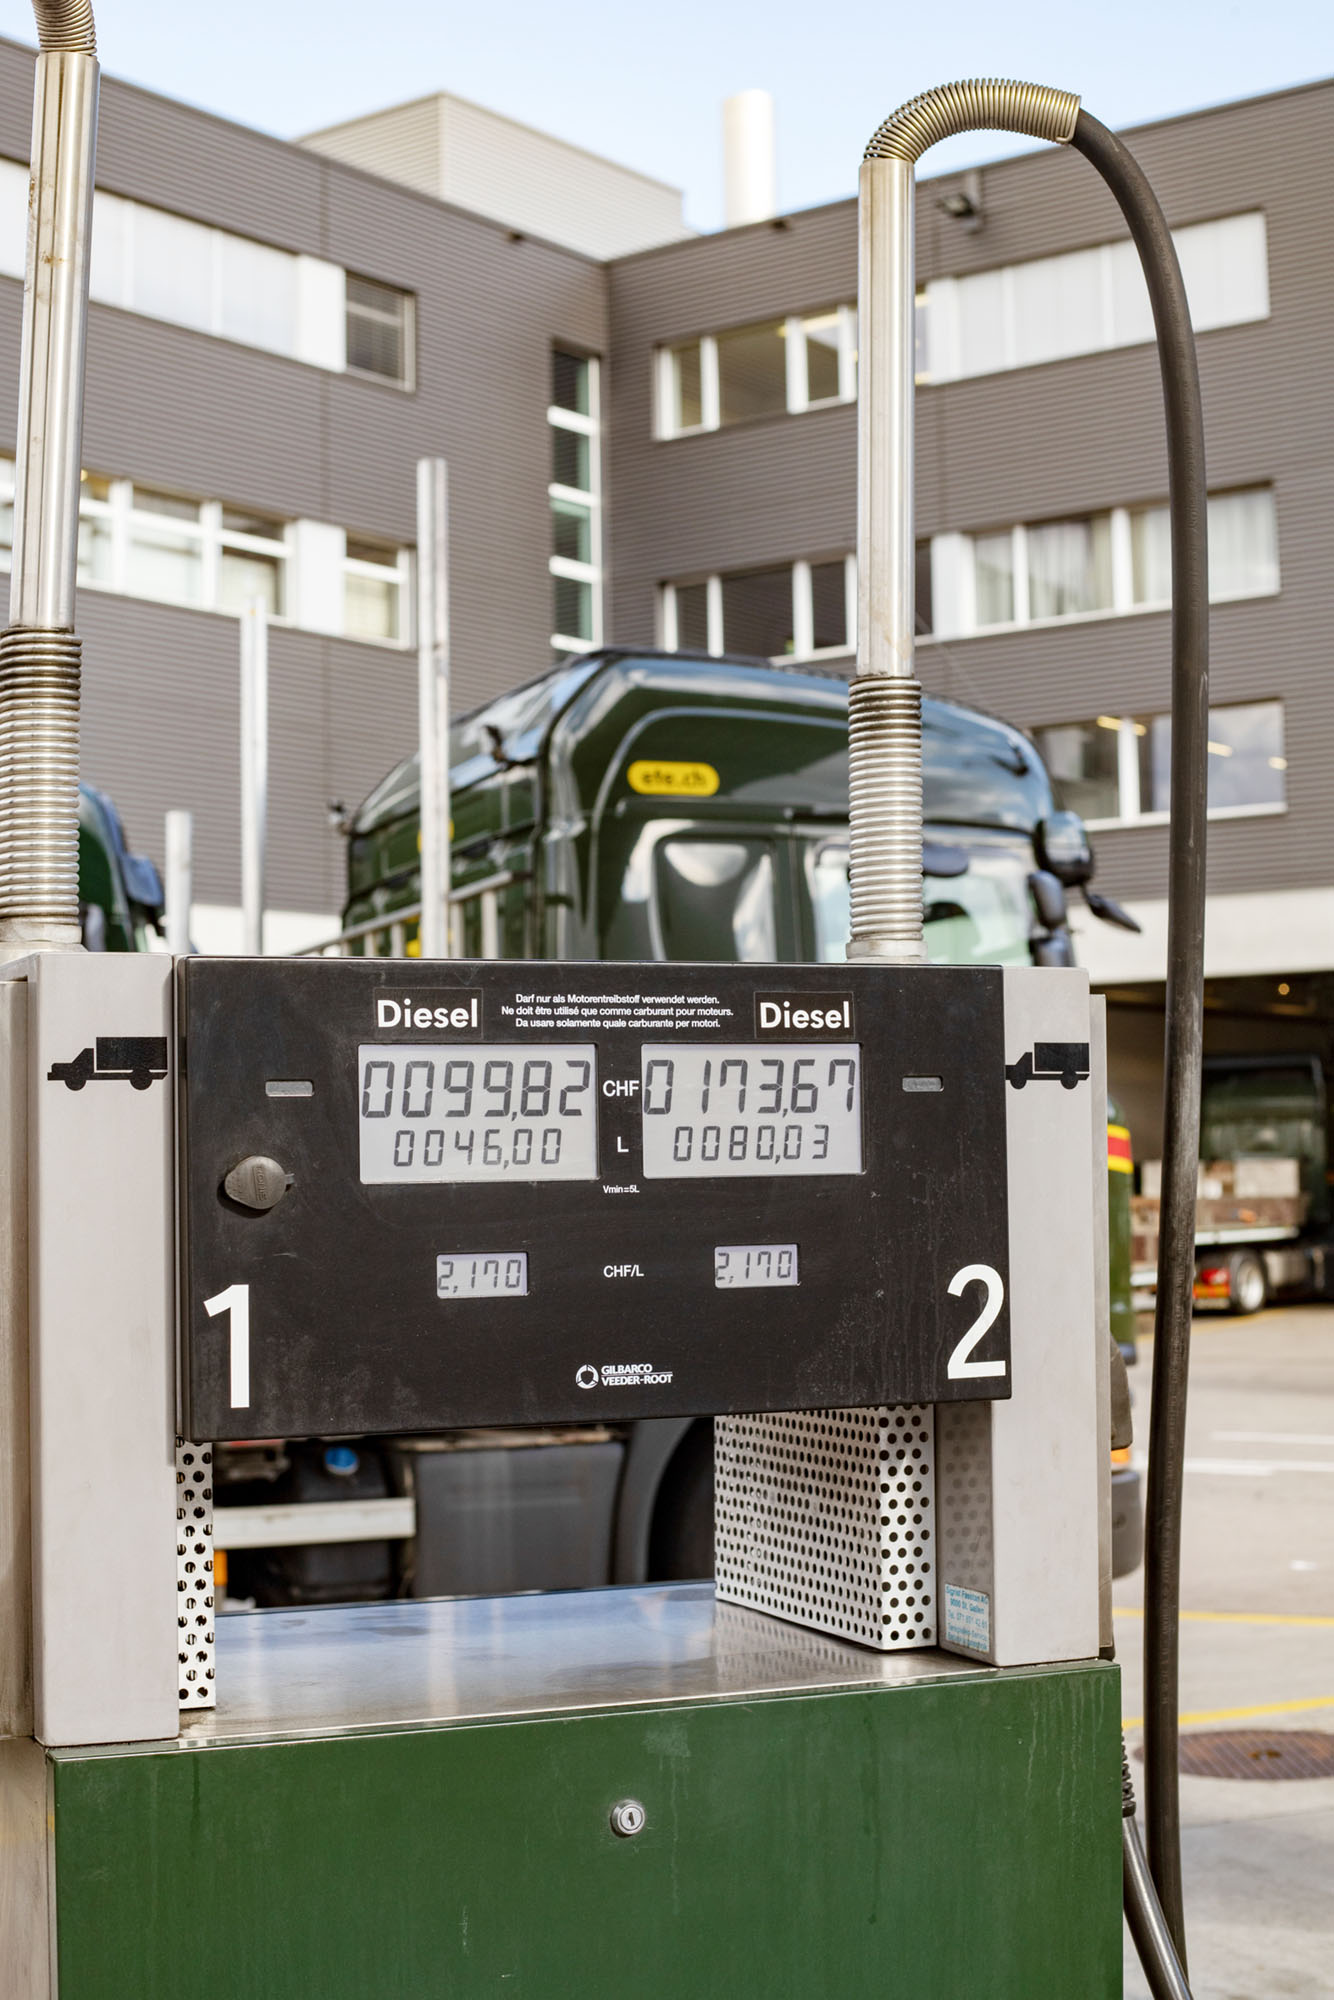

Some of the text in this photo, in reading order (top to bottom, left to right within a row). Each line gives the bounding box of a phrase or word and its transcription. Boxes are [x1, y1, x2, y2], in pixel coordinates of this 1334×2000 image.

[516, 994, 535, 1003] Darf
[552, 994, 566, 1003] als
[567, 994, 641, 1003] Motorentreibstoff
[641, 994, 686, 1003] verwendet
[686, 995, 720, 1004] werden.
[377, 998, 478, 1029] Diesel
[501, 1006, 515, 1015] Ne
[516, 1006, 534, 1015] doit
[535, 1006, 552, 1015] être
[554, 1006, 579, 1015] utilisé
[581, 1008, 598, 1017] que
[633, 1006, 675, 1015] carburant
[675, 1008, 696, 1018] pour
[697, 1007, 734, 1016] moteurs.
[760, 1001, 850, 1029] Diesel
[515, 1018, 529, 1027] Da
[556, 1018, 601, 1027] solamente
[602, 1018, 627, 1029] quale
[628, 1018, 674, 1027] carburante
[675, 1021, 690, 1030] per
[691, 1019, 720, 1028] motori.
[362, 1060, 590, 1121] 0099,82
[602, 1079, 640, 1097] CHF
[394, 1128, 562, 1170] 0046,00
[617, 1136, 630, 1153] L
[673, 1124, 830, 1164] 0080,03
[602, 1184, 640, 1194] Vmin=5L
[438, 1259, 522, 1293] 2,170
[603, 1264, 645, 1278] CHF/L
[716, 1250, 792, 1283] 2,170
[947, 1263, 1006, 1380] 2
[203, 1284, 250, 1409] 1
[601, 1363, 653, 1375] GILBARCO
[601, 1373, 674, 1387] VEEDER-ROOT
